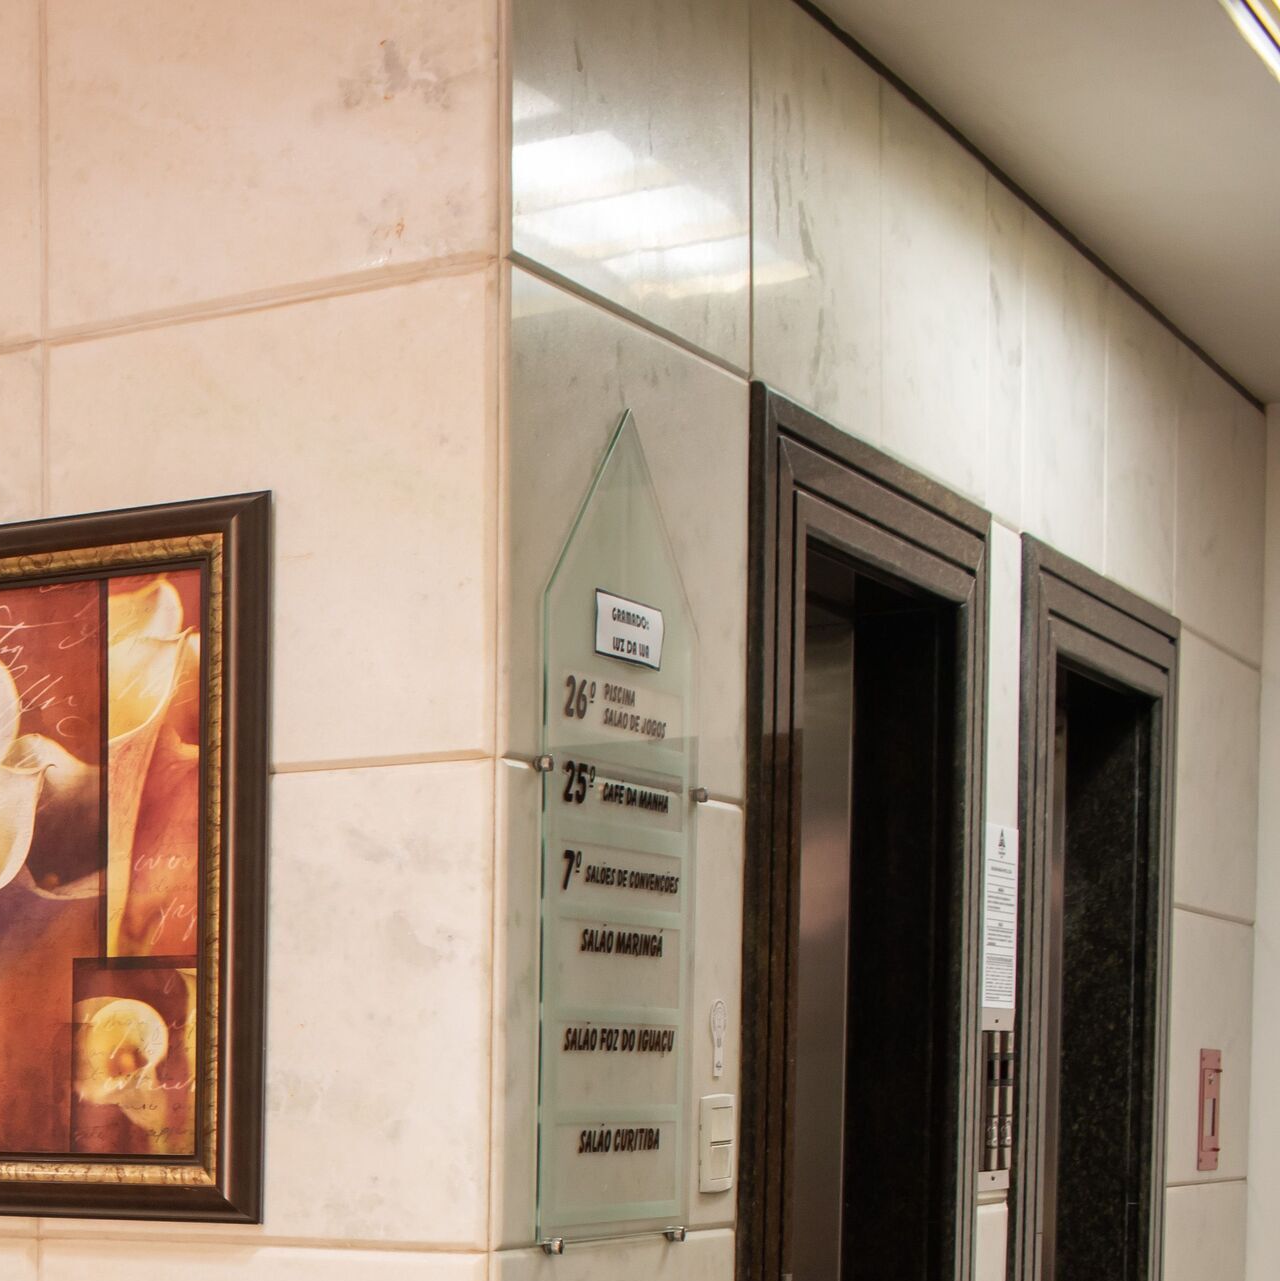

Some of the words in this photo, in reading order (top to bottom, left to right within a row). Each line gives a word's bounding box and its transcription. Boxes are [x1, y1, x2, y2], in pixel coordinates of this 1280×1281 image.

[626, 640, 637, 655] DA
[603, 683, 636, 707] PISCINA
[629, 714, 640, 732] DE
[640, 718, 667, 740] JOGOS
[602, 780, 625, 805] CAFÉ
[626, 787, 637, 806] DA
[585, 861, 616, 885] SALÕES
[617, 869, 628, 887] DE
[615, 928, 663, 957] MARINGÁ
[600, 1028, 620, 1052] FOZ
[621, 1029, 636, 1052] DO
[637, 1029, 675, 1058] IGUAÇU
[613, 1128, 660, 1152] CURITIBA
